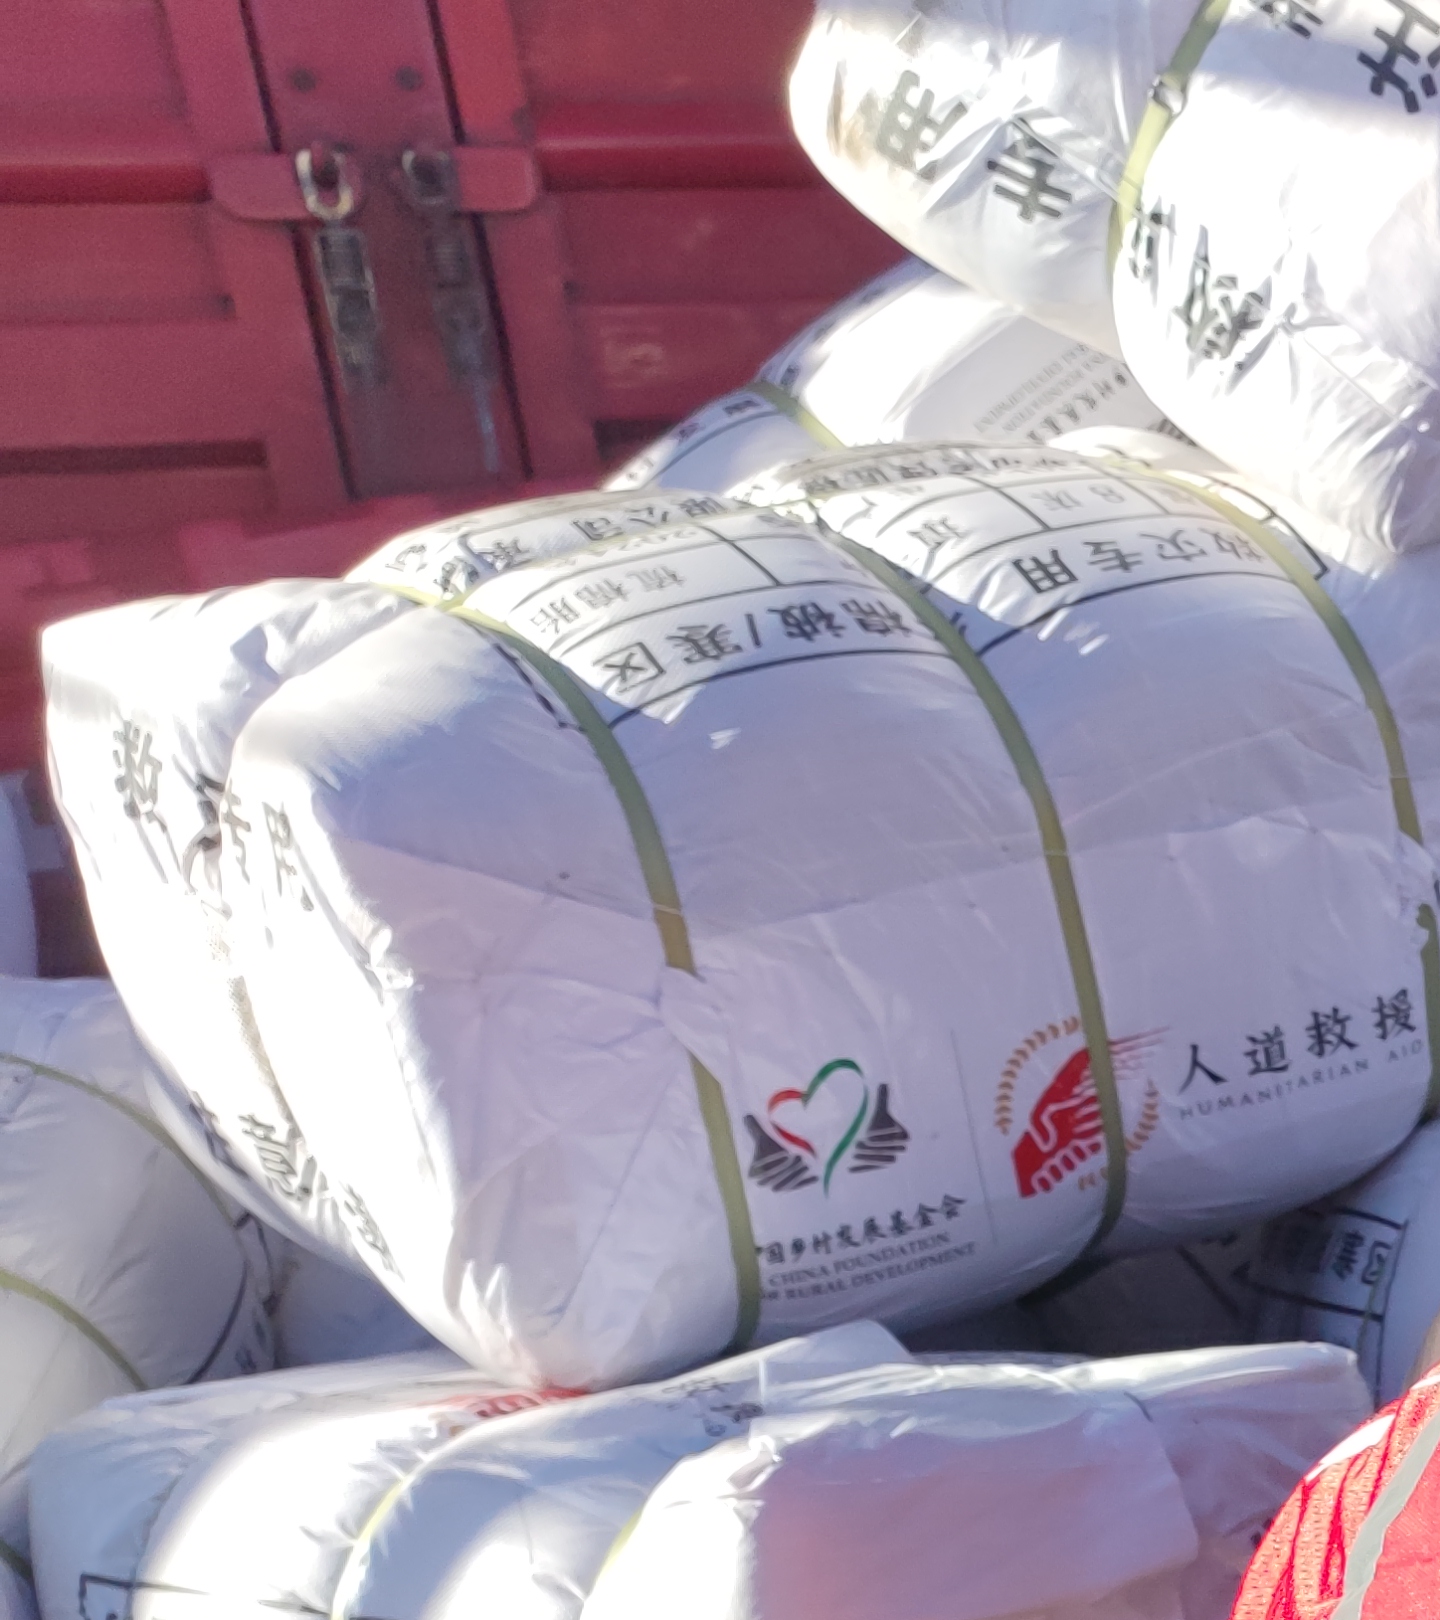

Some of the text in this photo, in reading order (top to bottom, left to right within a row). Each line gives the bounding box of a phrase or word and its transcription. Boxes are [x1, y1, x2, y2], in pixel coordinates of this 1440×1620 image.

[1177, 988, 1419, 1093] 人道救援
[1180, 1040, 1424, 1121] HUMANITARIAN AID
[755, 1194, 966, 1267] 国乡村发展基金会
[769, 1231, 951, 1289] CHINA FOUNDATION
[784, 1242, 977, 1302] RURAL DEVELOPMENT
